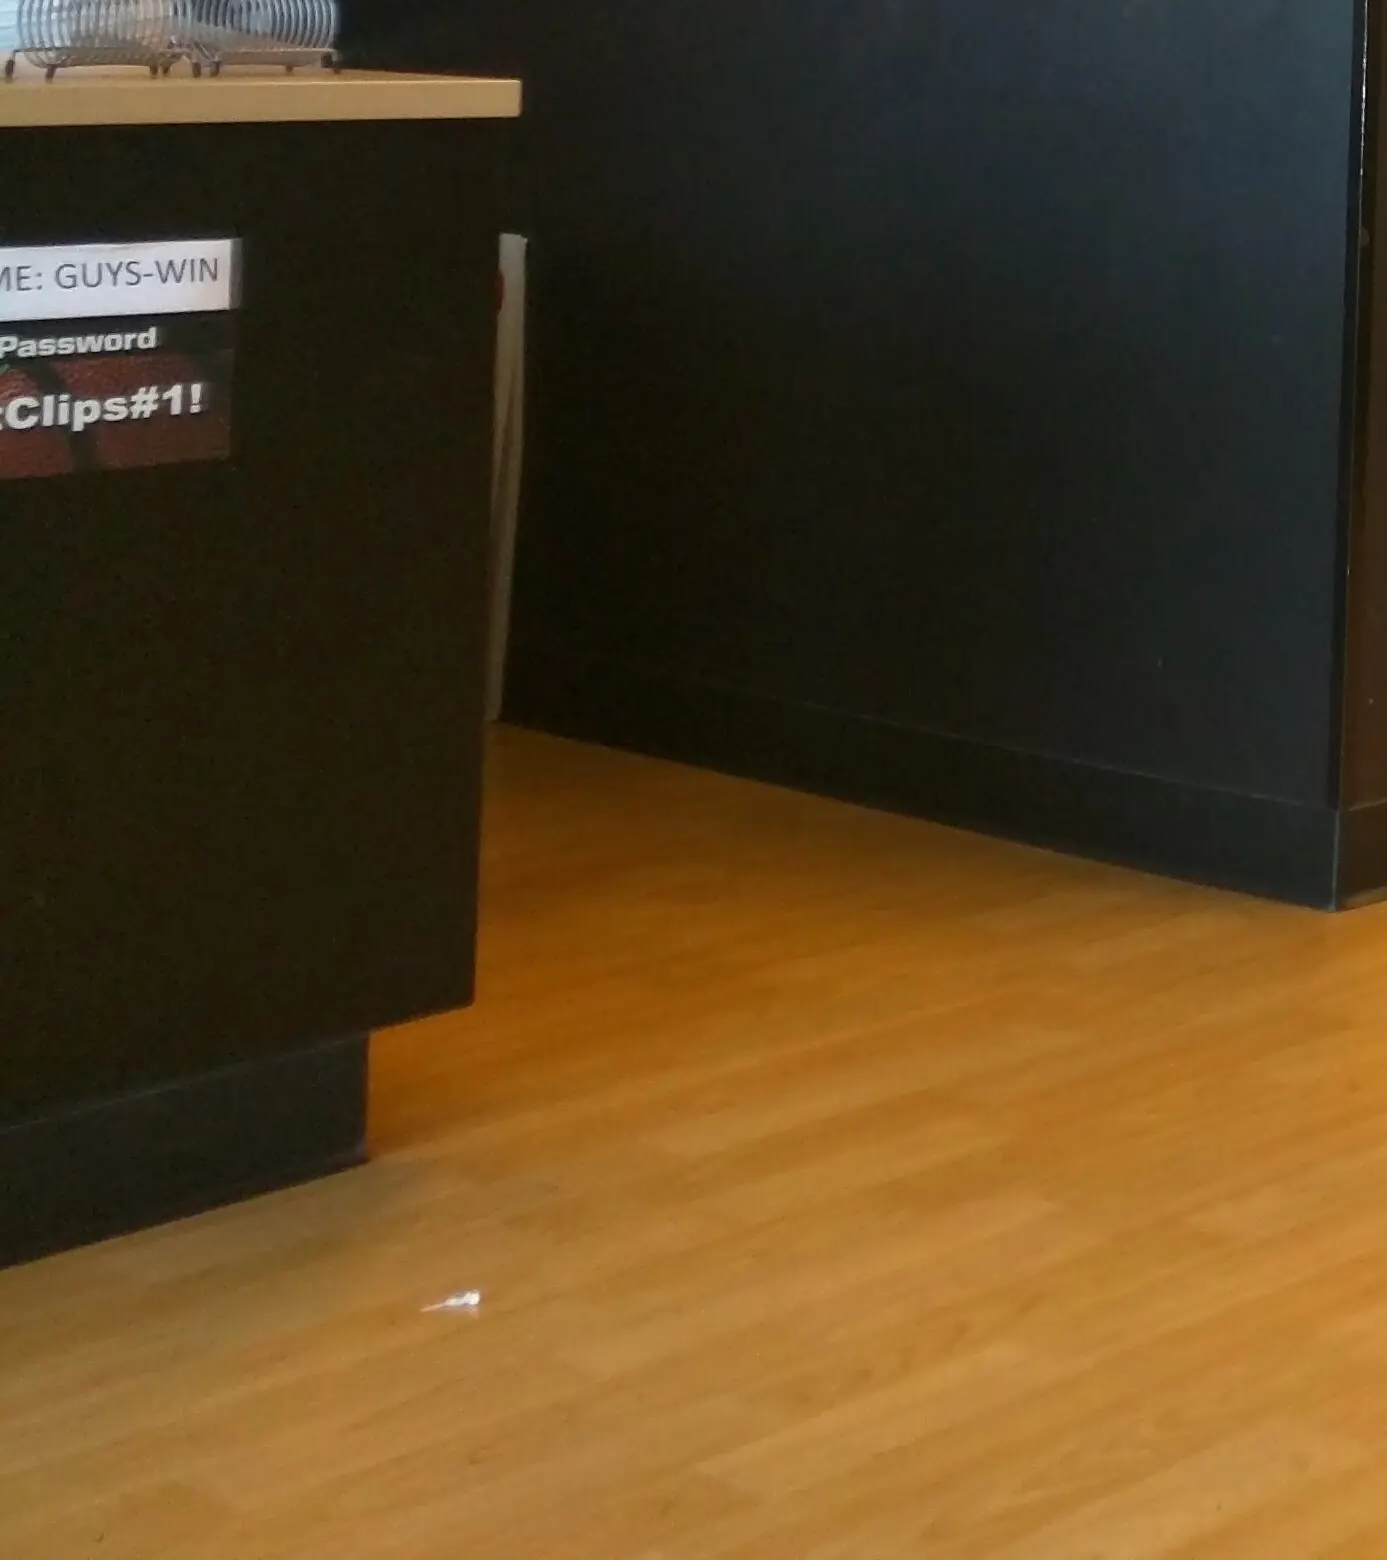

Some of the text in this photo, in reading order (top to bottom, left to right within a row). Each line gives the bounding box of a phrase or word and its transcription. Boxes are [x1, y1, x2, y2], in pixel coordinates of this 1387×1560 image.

[54, 257, 219, 290] GUYS-WIN
[0, 327, 157, 360] Password
[0, 383, 202, 431] Clips#1!
